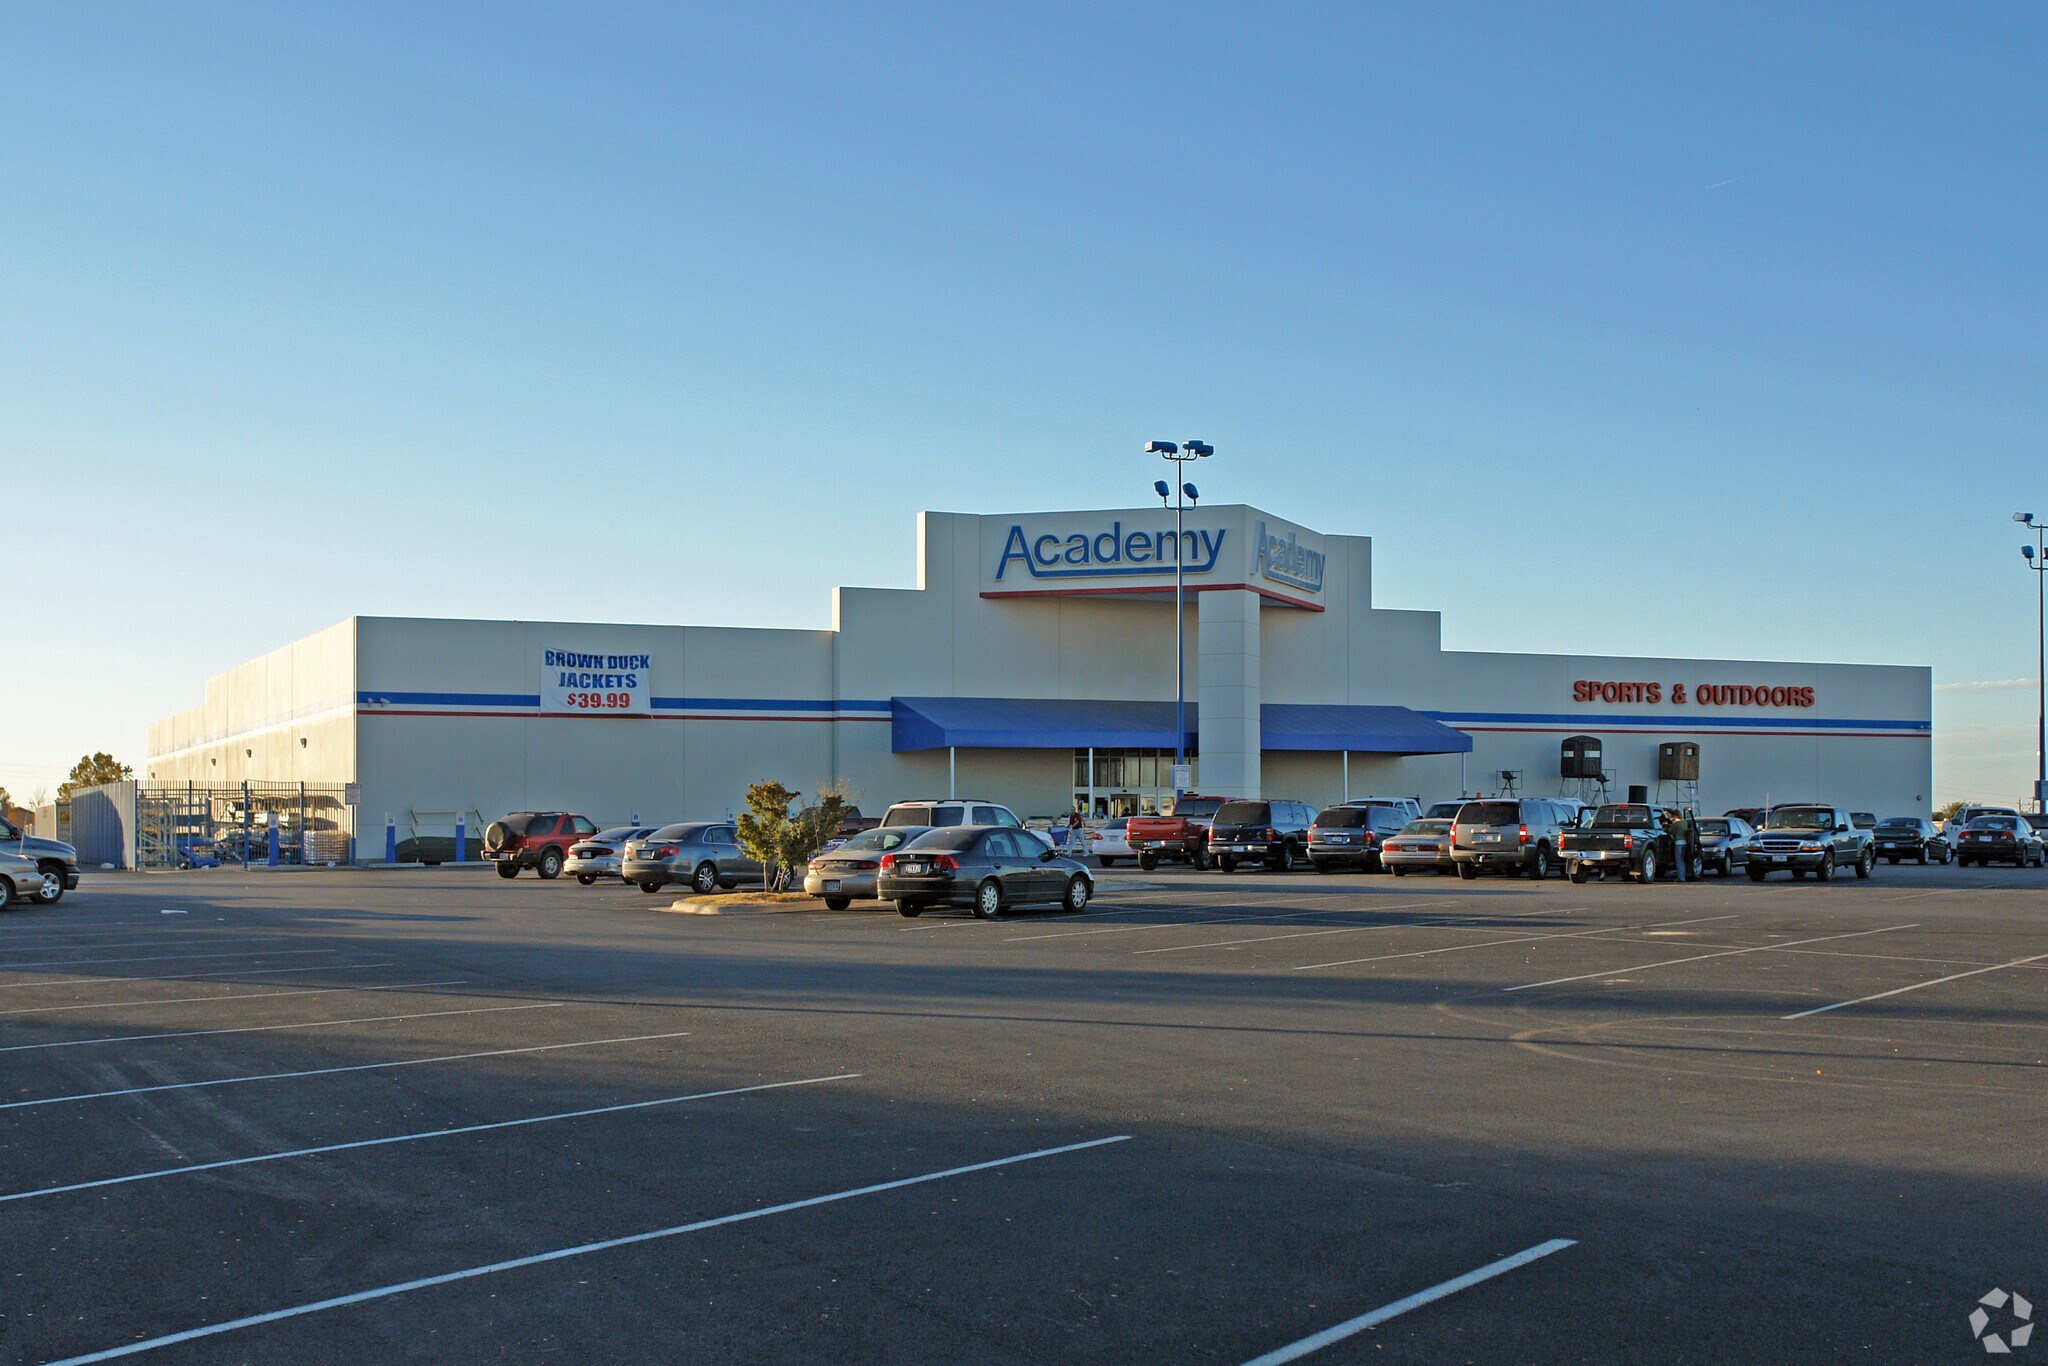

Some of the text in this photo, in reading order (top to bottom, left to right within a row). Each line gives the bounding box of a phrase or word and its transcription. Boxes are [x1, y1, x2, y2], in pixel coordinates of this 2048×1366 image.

[995, 521, 1226, 581] Academy
[1252, 521, 1325, 592] Academy
[545, 650, 650, 670] BROWN DUCK
[558, 672, 638, 689] JACKETS
[567, 692, 630, 708] $39.99
[1573, 680, 1815, 707] SPORTS & OUTDOORS
